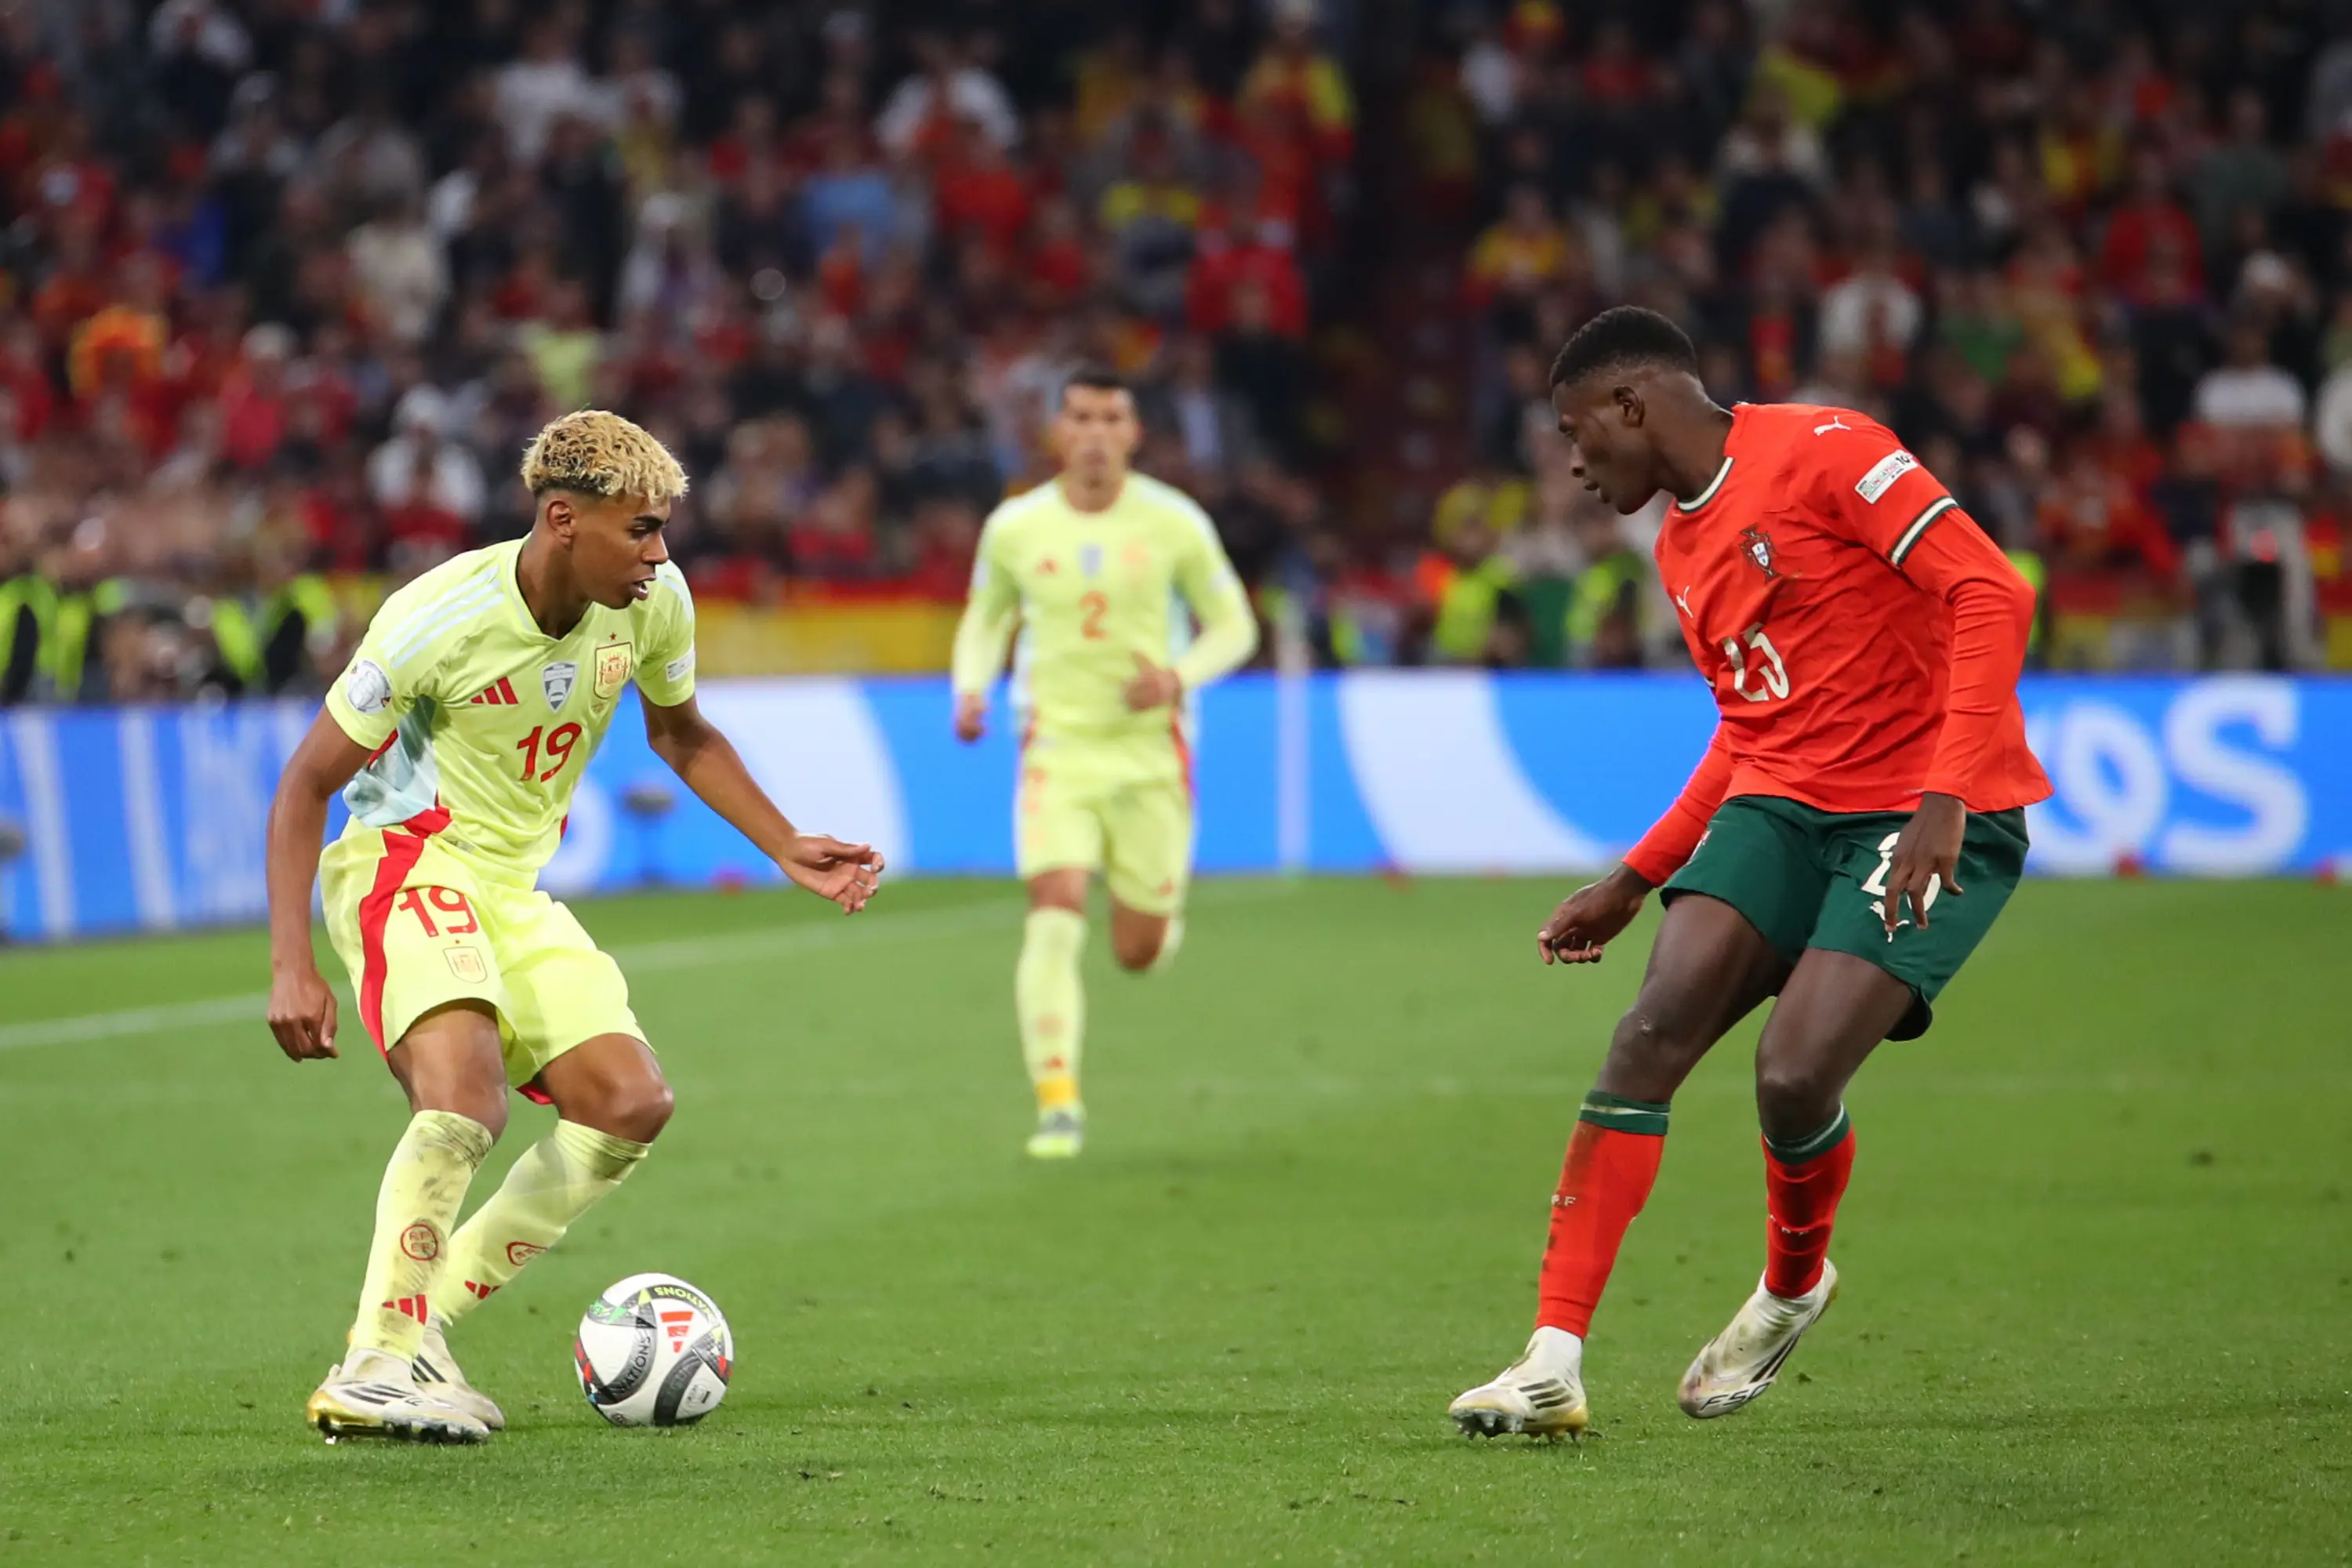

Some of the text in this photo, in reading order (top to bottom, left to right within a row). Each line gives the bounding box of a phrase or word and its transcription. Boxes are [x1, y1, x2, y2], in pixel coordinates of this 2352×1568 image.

[1079, 590, 1110, 641] 2
[517, 721, 583, 782] 19
[397, 886, 478, 938] 19
